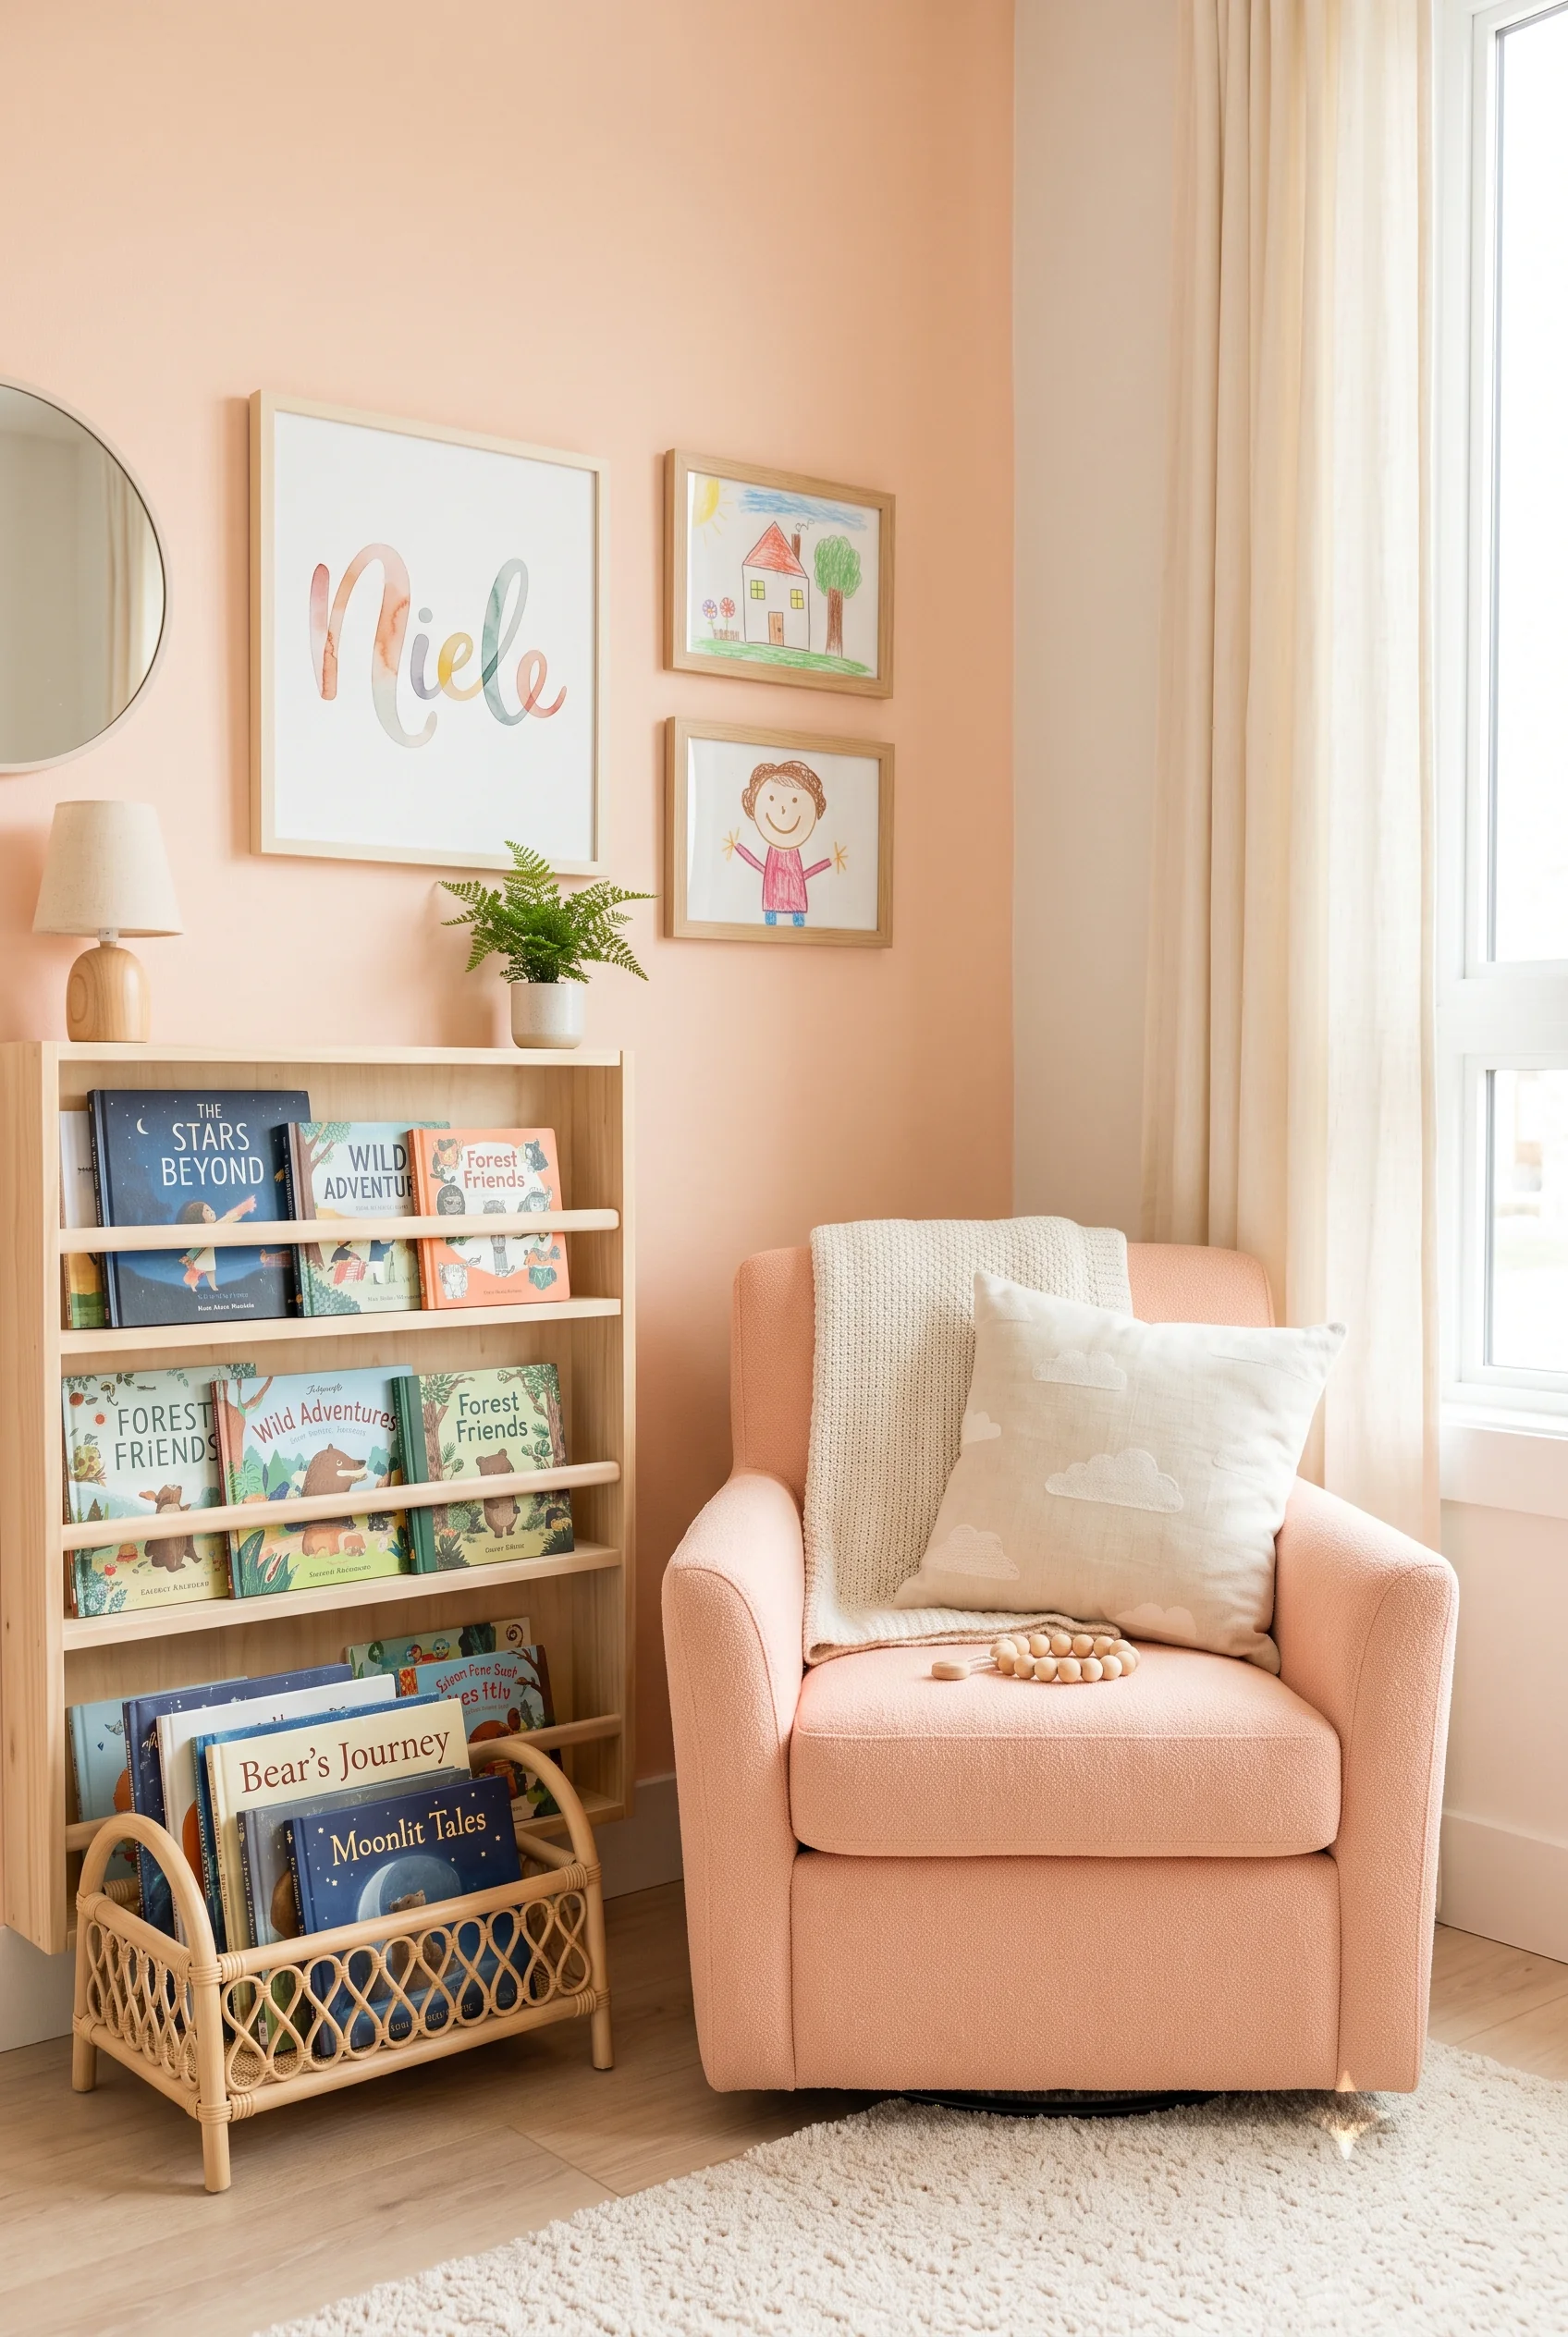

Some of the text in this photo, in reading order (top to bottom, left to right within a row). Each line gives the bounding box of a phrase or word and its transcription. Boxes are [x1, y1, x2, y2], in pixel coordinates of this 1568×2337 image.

[309, 542, 567, 749] Niele
[196, 1103, 223, 1119] THE
[172, 1122, 250, 1152] STARS
[161, 1156, 264, 1186] BEYOND
[348, 1144, 407, 1171] WILD
[466, 1149, 518, 1168] Forest
[463, 1168, 525, 1189] Friends
[458, 1391, 520, 1416] Forest
[117, 1401, 213, 1437] FOREST
[251, 1406, 296, 1444] Wild
[300, 1399, 397, 1432] Adventures
[456, 1414, 529, 1443] Friends
[337, 1731, 451, 1782] Journey
[329, 1806, 487, 1866] Moonlit Tales
